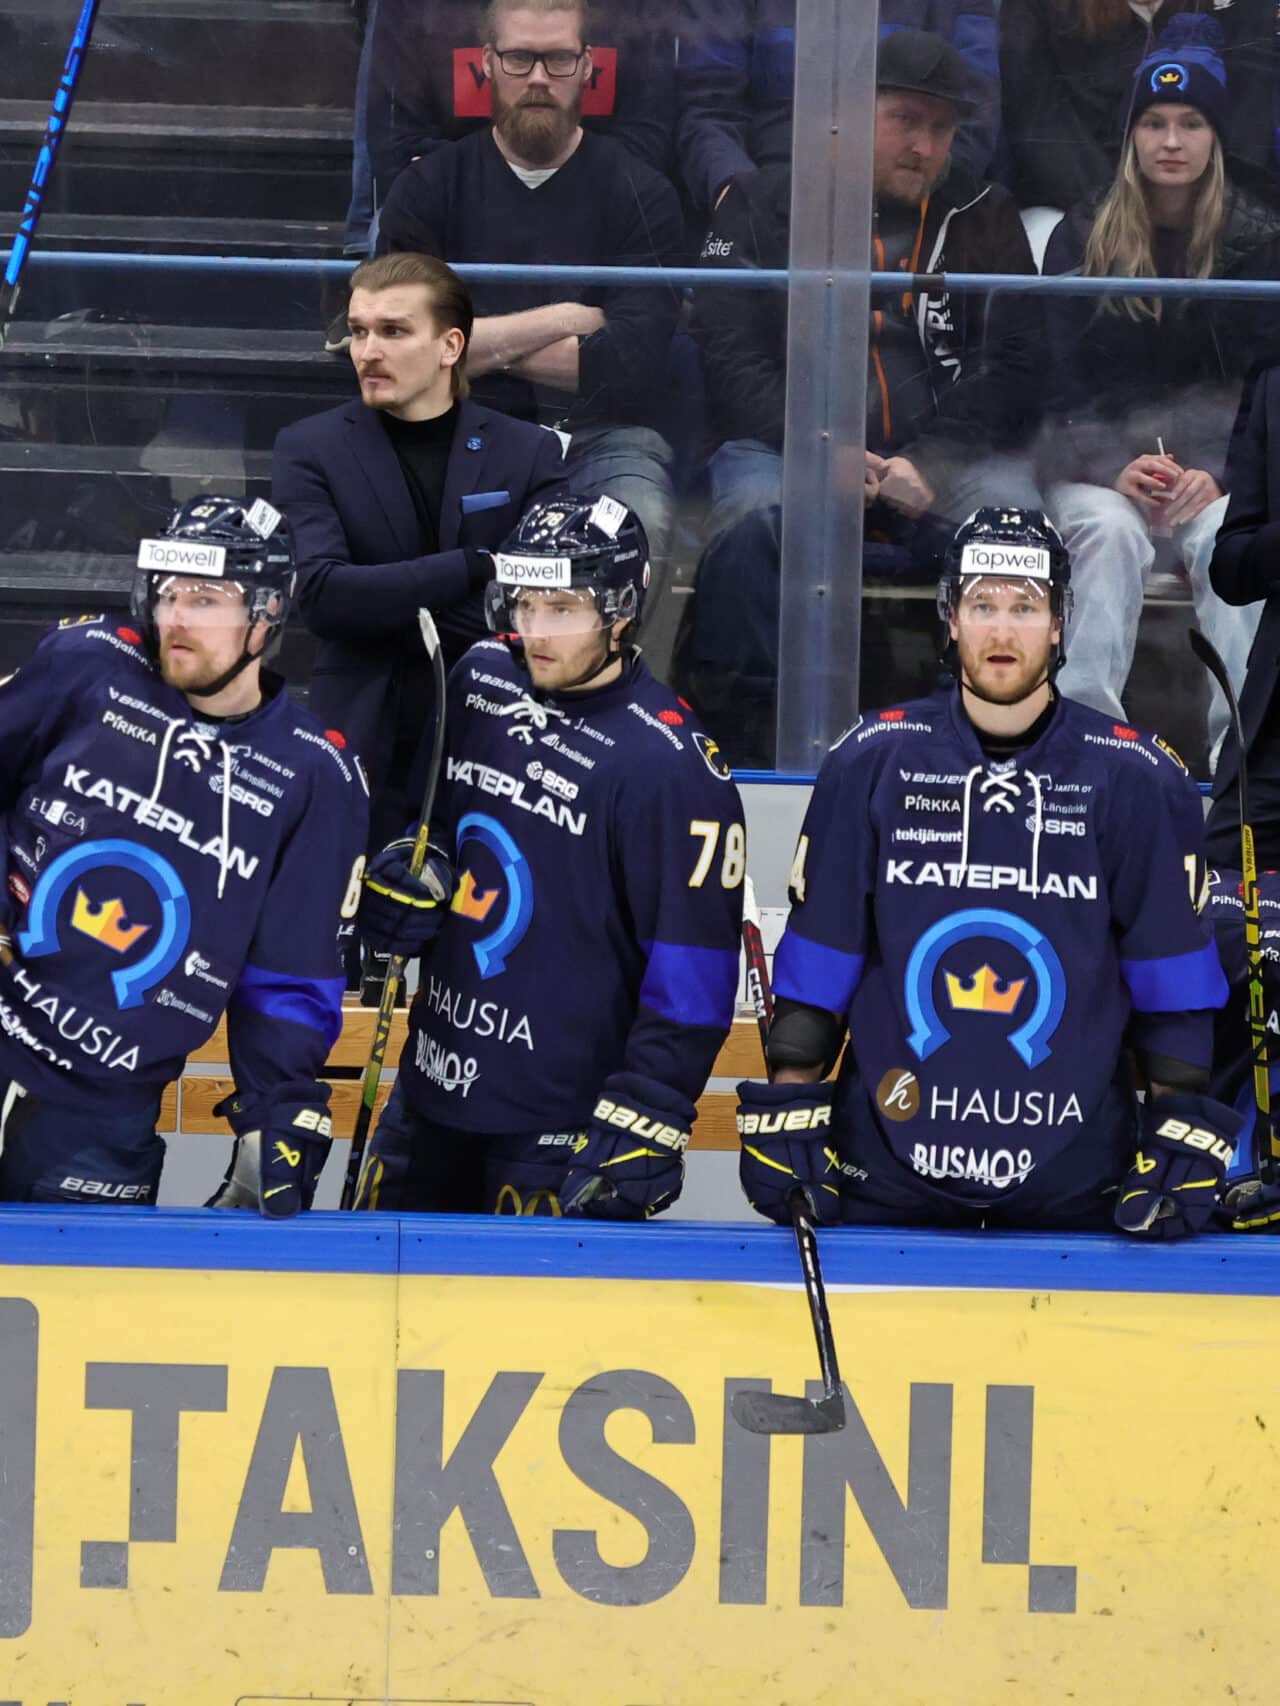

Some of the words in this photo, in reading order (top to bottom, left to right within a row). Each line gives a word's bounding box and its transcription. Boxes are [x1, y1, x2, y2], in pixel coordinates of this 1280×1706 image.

[539, 512, 564, 527] 78
[999, 514, 1021, 524] 14
[147, 544, 217, 567] Tapwell
[500, 558, 563, 581] Tapwell
[970, 548, 1044, 570] Tapwell
[857, 721, 932, 743] Pihlajalinna
[1084, 734, 1158, 766] Pihlajalinna
[293, 727, 352, 782] Pihlajalinna
[229, 784, 274, 817] SRG
[446, 756, 588, 836] KATEPLAN
[63, 763, 260, 881] KATEPLAN
[1045, 819, 1086, 836] SRG
[688, 819, 746, 889] 78
[886, 859, 1097, 900] KATEPLAN
[427, 975, 535, 1051] HAUSIA
[748, 967, 768, 1019] CCM
[13, 968, 140, 1072] HAUSIA
[593, 1099, 689, 1151] BAUER
[930, 1085, 1084, 1126] HAUSIA
